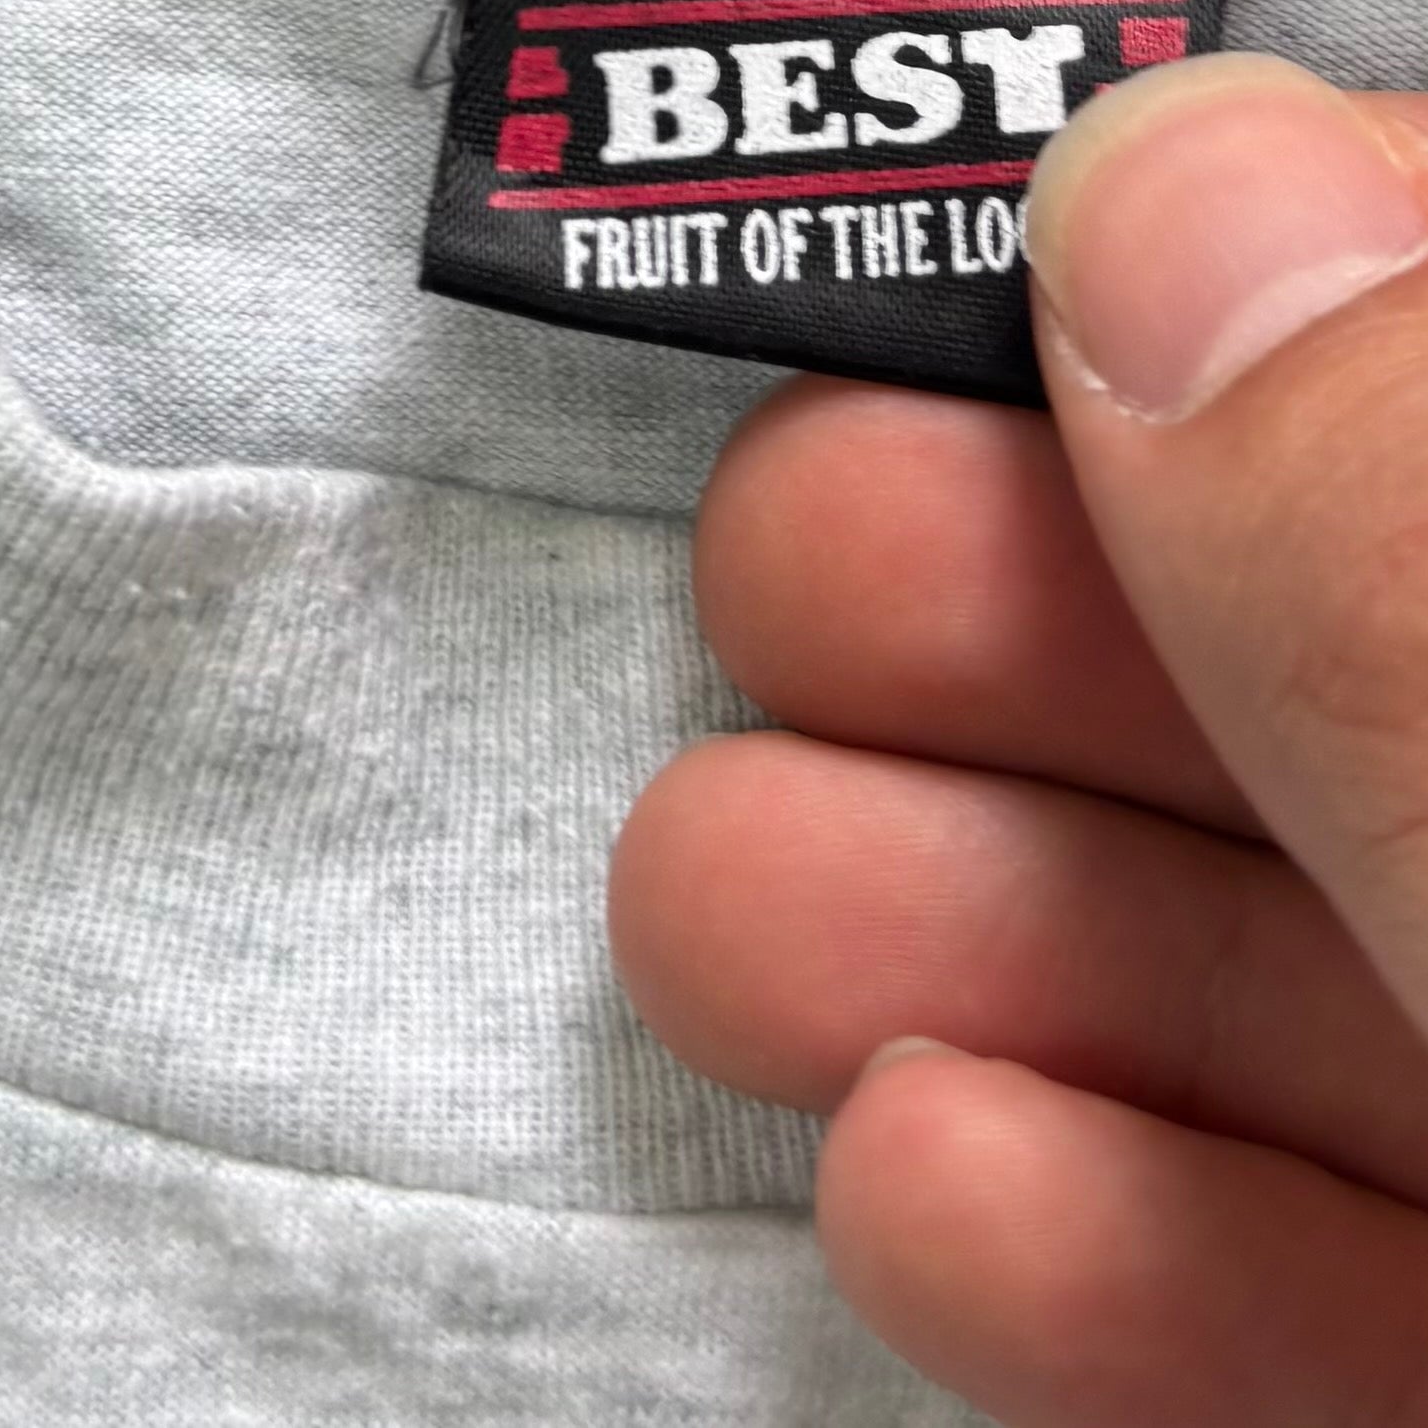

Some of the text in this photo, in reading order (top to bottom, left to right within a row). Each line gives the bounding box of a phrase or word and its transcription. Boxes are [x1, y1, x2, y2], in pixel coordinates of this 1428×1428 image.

[592, 24, 1085, 165] BEST
[560, 210, 729, 291] FRUIT
[739, 206, 815, 286] OF
[817, 198, 938, 282] THE
